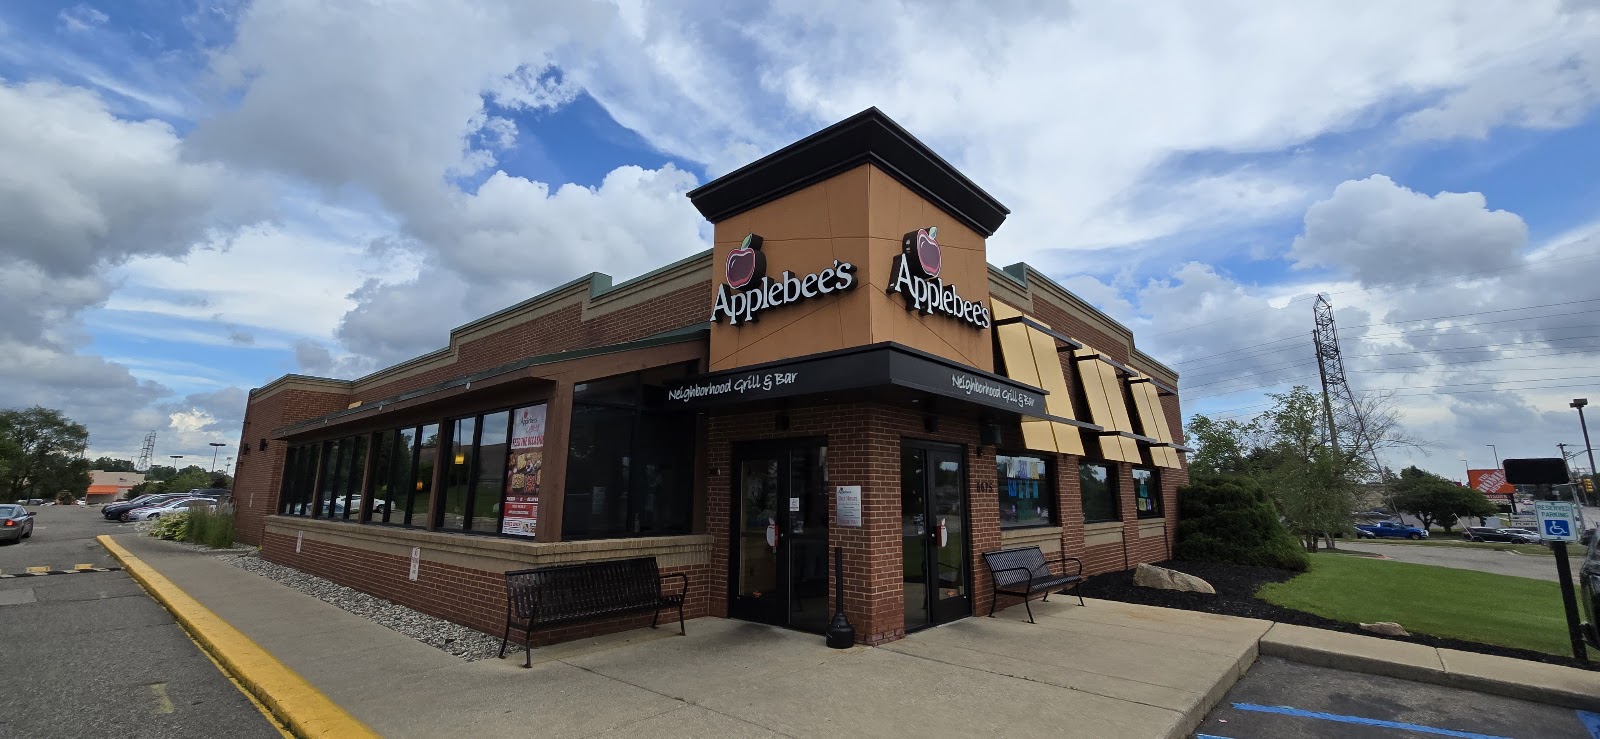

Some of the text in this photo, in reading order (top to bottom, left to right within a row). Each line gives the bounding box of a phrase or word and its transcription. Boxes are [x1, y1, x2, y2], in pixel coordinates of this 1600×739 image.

[710, 259, 852, 325] Applebee's
[890, 252, 990, 329] Applebee's
[668, 372, 798, 402] Neighborhood Grill & Bar
[951, 373, 1035, 407] Neighborhood Grill & Bar
[1478, 473, 1489, 483] THE
[1536, 504, 1571, 512] RESERVED
